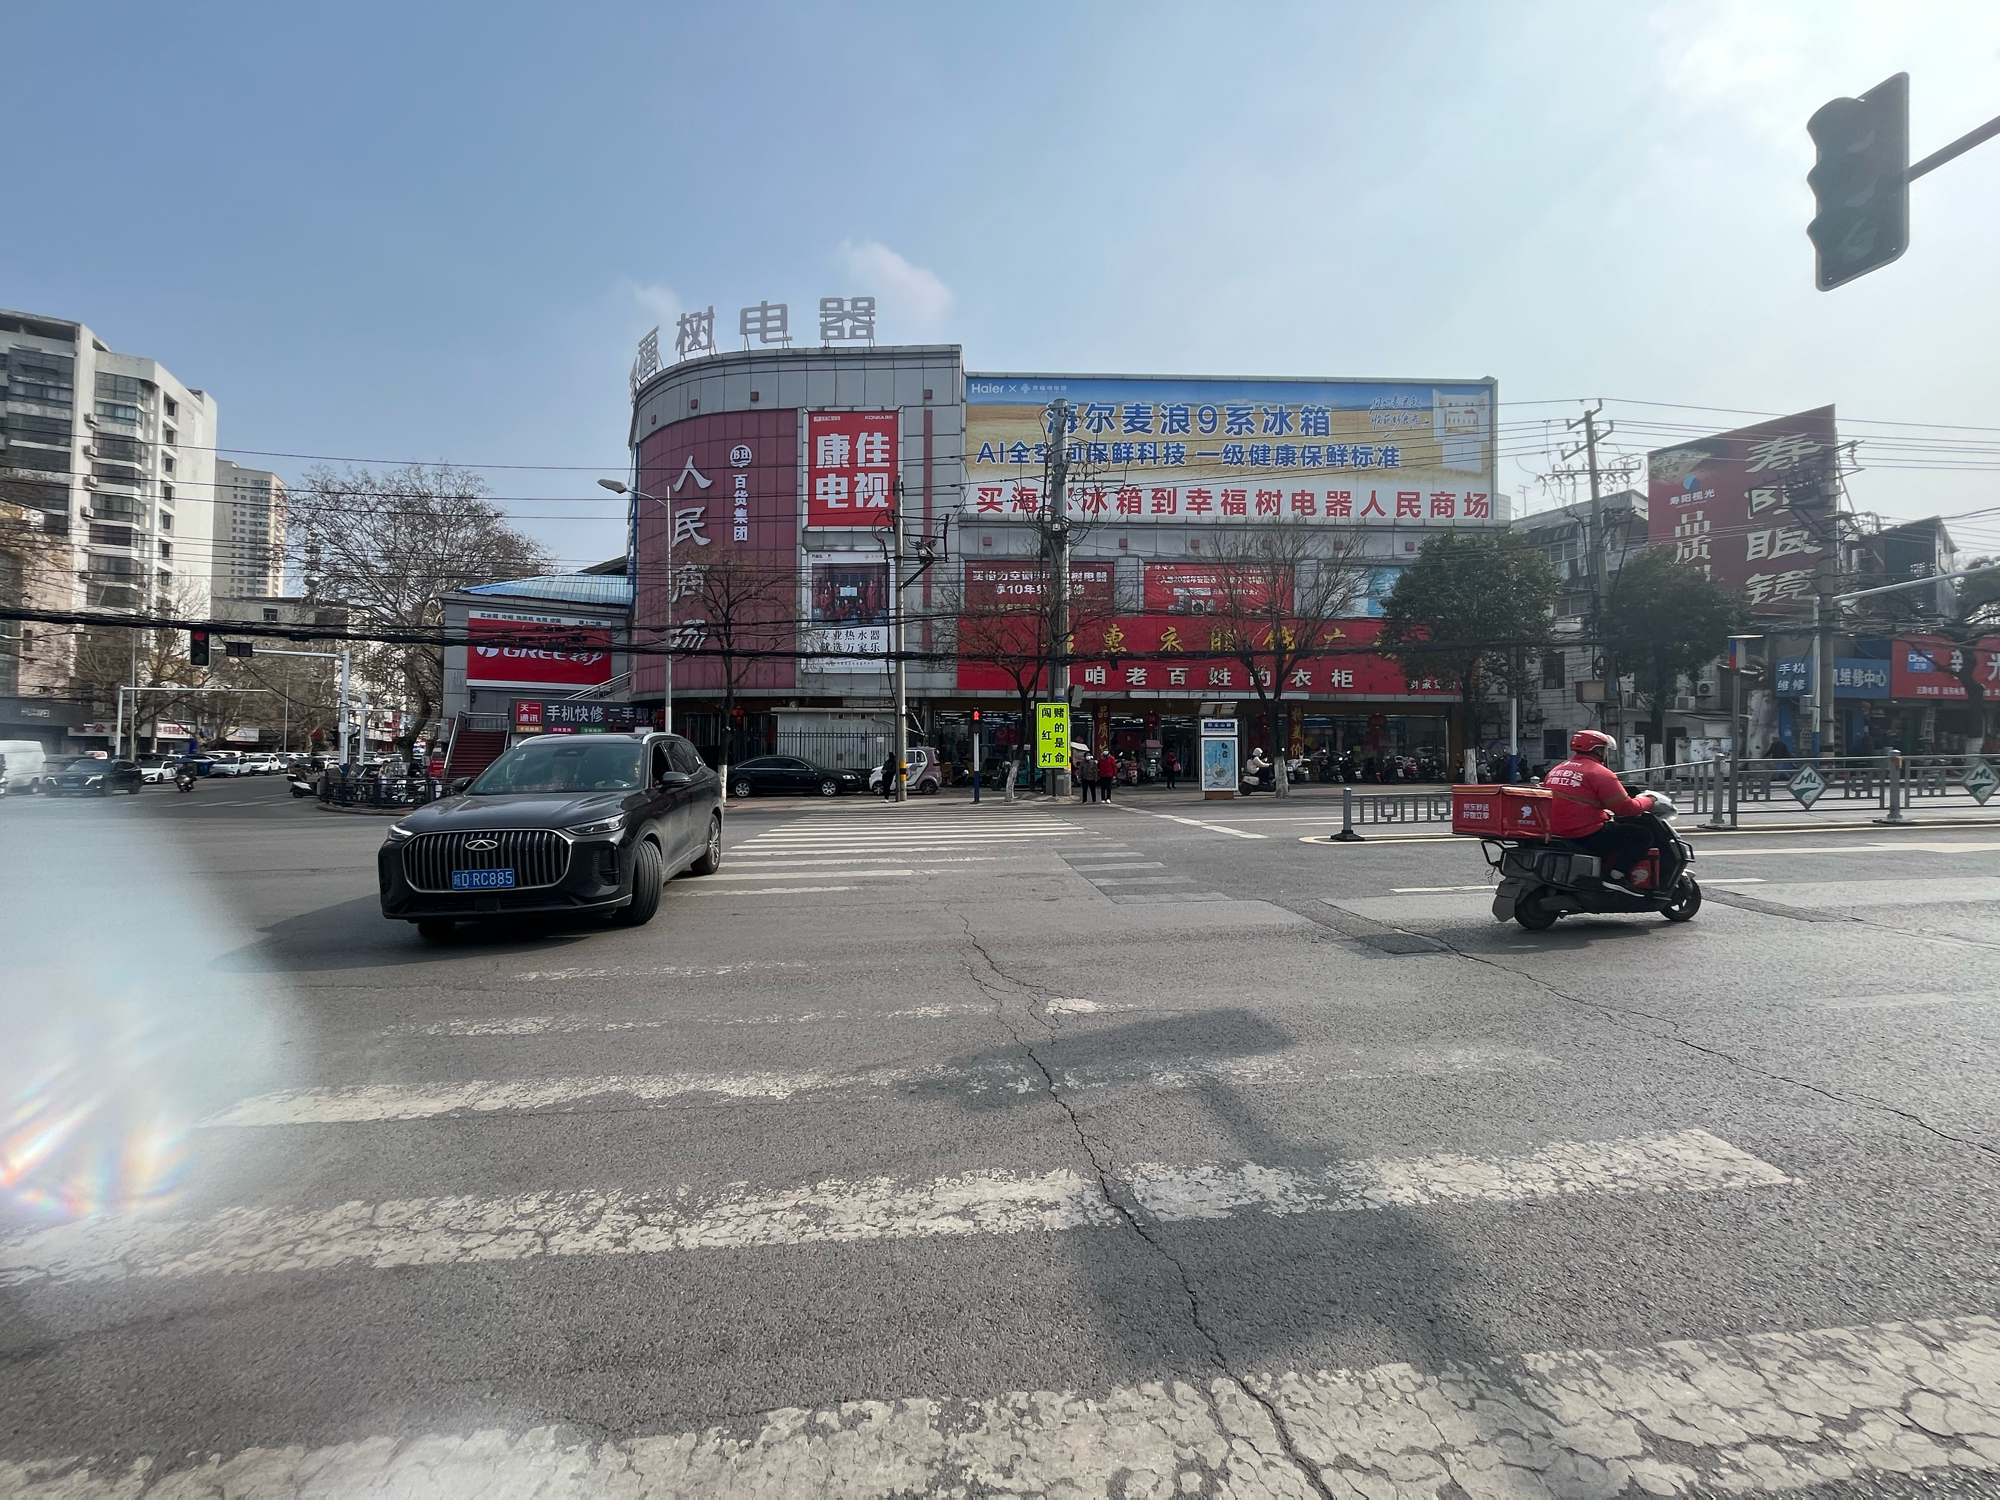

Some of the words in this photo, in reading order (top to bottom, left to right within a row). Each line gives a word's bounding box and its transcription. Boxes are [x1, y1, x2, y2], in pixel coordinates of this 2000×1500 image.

[971, 383, 1004, 394] Haier
[816, 432, 890, 468] 康佳
[1196, 443, 1401, 468] 一级健康保鲜标准
[815, 472, 890, 508] 电视
[733, 473, 749, 541] 百货集团
[822, 630, 880, 640] 专业热水器
[1084, 665, 1354, 688] 咱老百姓的衣柜
[1778, 663, 1806, 675] 手机
[1777, 680, 1806, 691] 维修
[520, 704, 539, 712] 天一
[520, 714, 539, 722] 通讯
[546, 705, 603, 722] 手机快修
[1041, 707, 1052, 763] 闯红灯
[1054, 707, 1065, 763] 赌的是命
